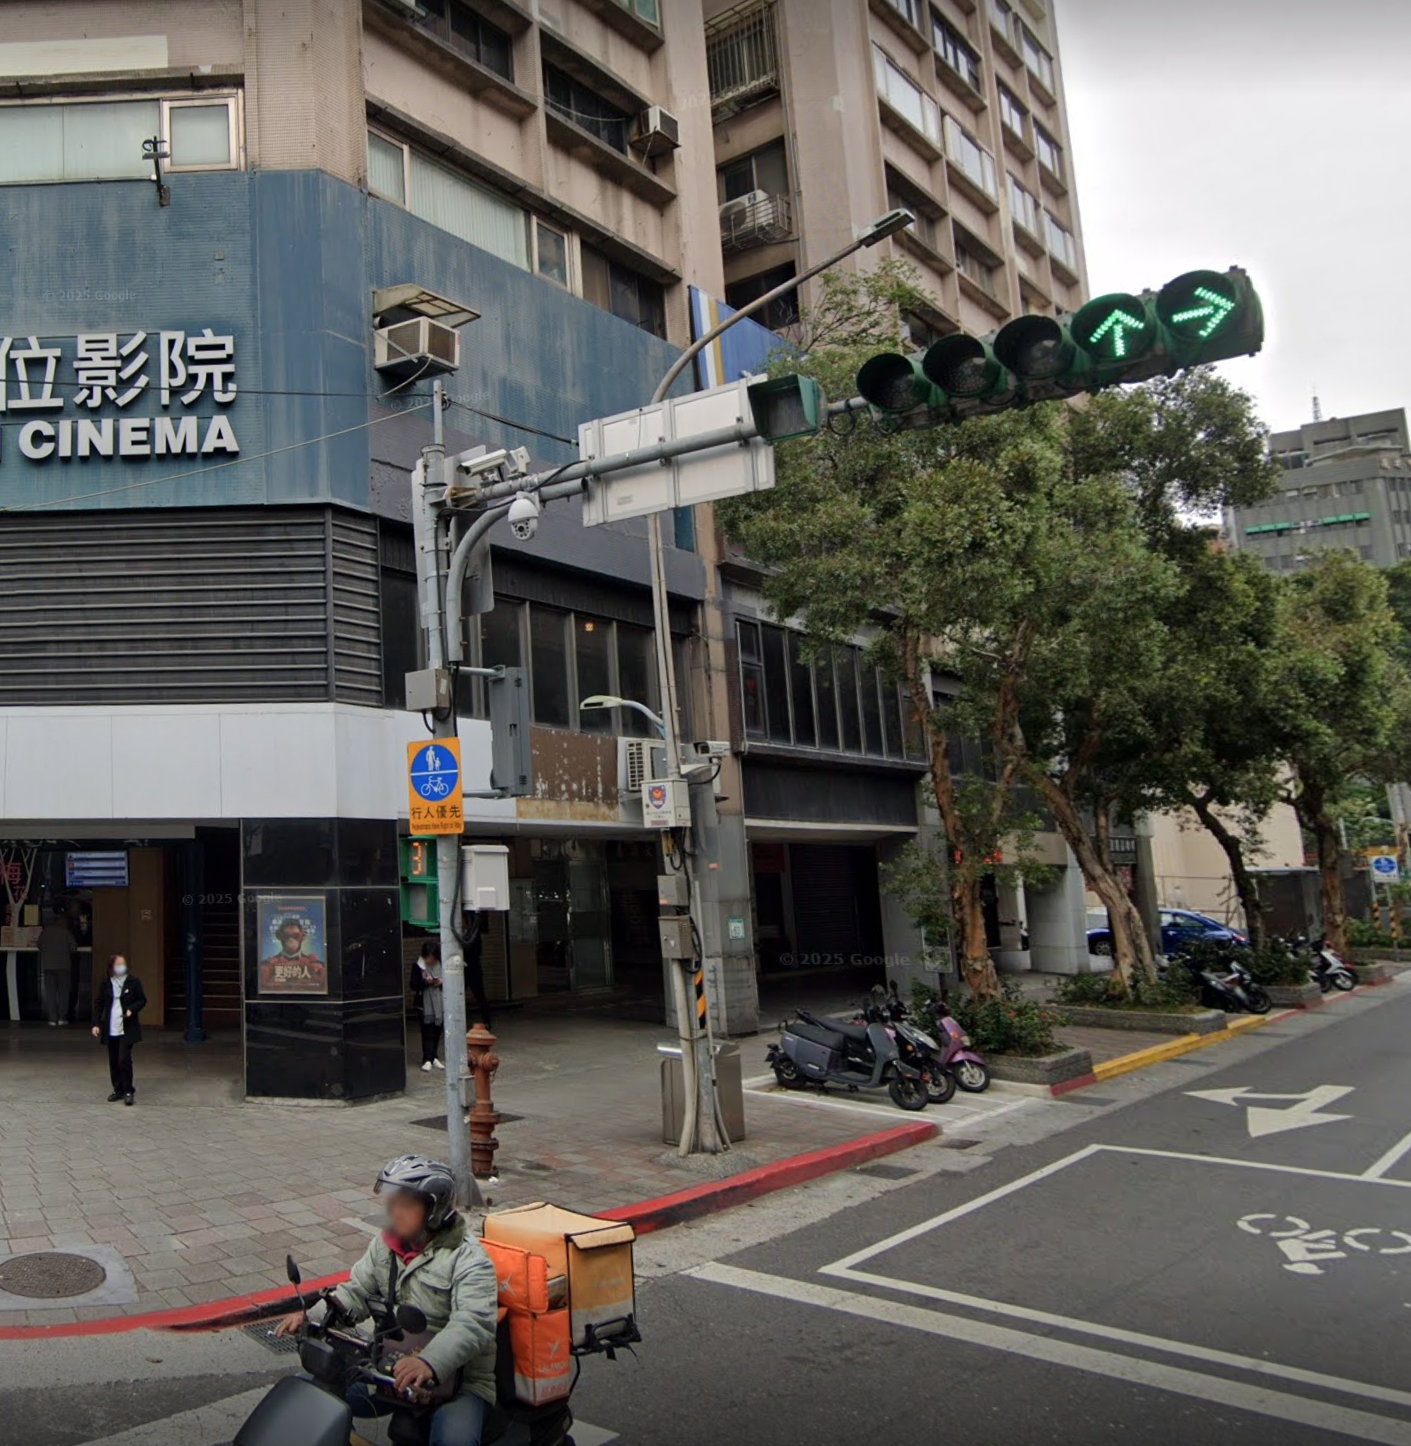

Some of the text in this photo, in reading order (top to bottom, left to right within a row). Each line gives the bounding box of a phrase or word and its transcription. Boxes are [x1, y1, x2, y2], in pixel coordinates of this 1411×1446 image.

[18, 414, 240, 459] CINEMA
[411, 804, 461, 820] 行人優先
[274, 965, 311, 979] 更好的人
